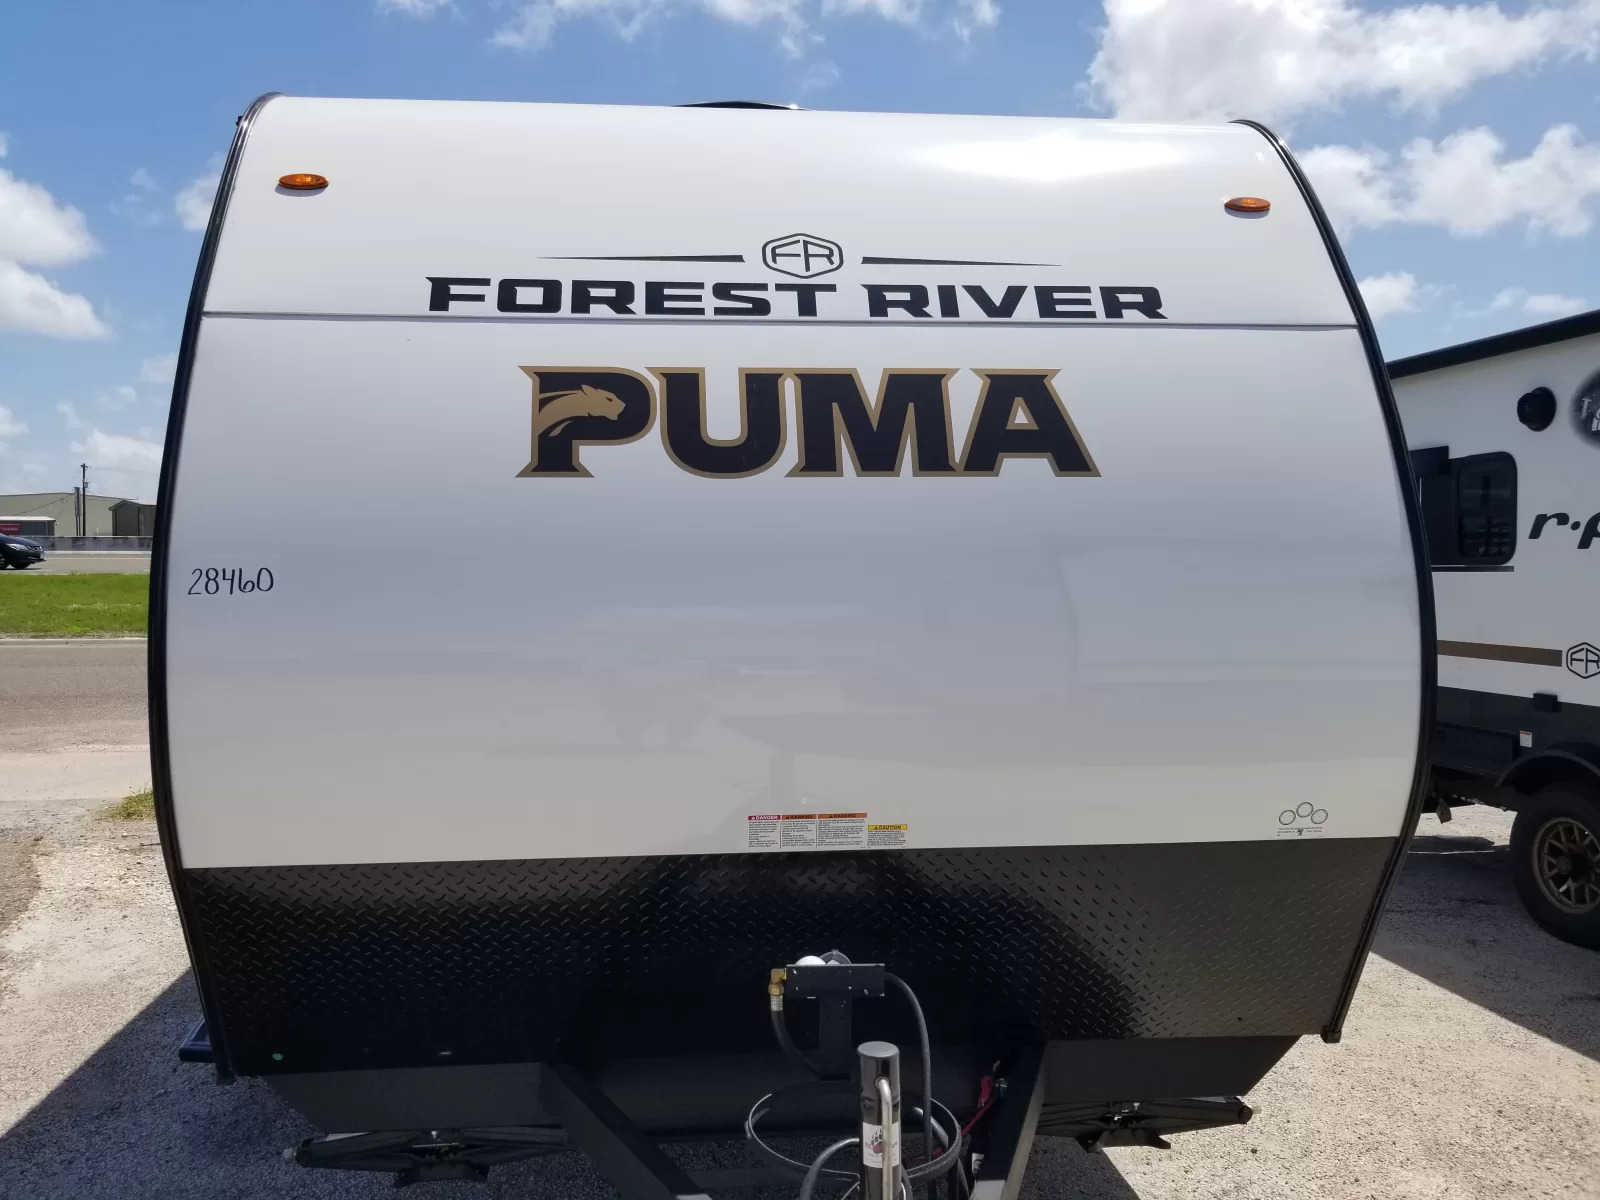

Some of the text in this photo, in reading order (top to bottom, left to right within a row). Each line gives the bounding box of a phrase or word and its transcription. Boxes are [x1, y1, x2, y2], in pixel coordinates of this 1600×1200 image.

[770, 238, 836, 274] FR
[424, 276, 1168, 320] FOREST RIVER
[514, 365, 1102, 478] PUMA
[187, 567, 274, 596] 28460
